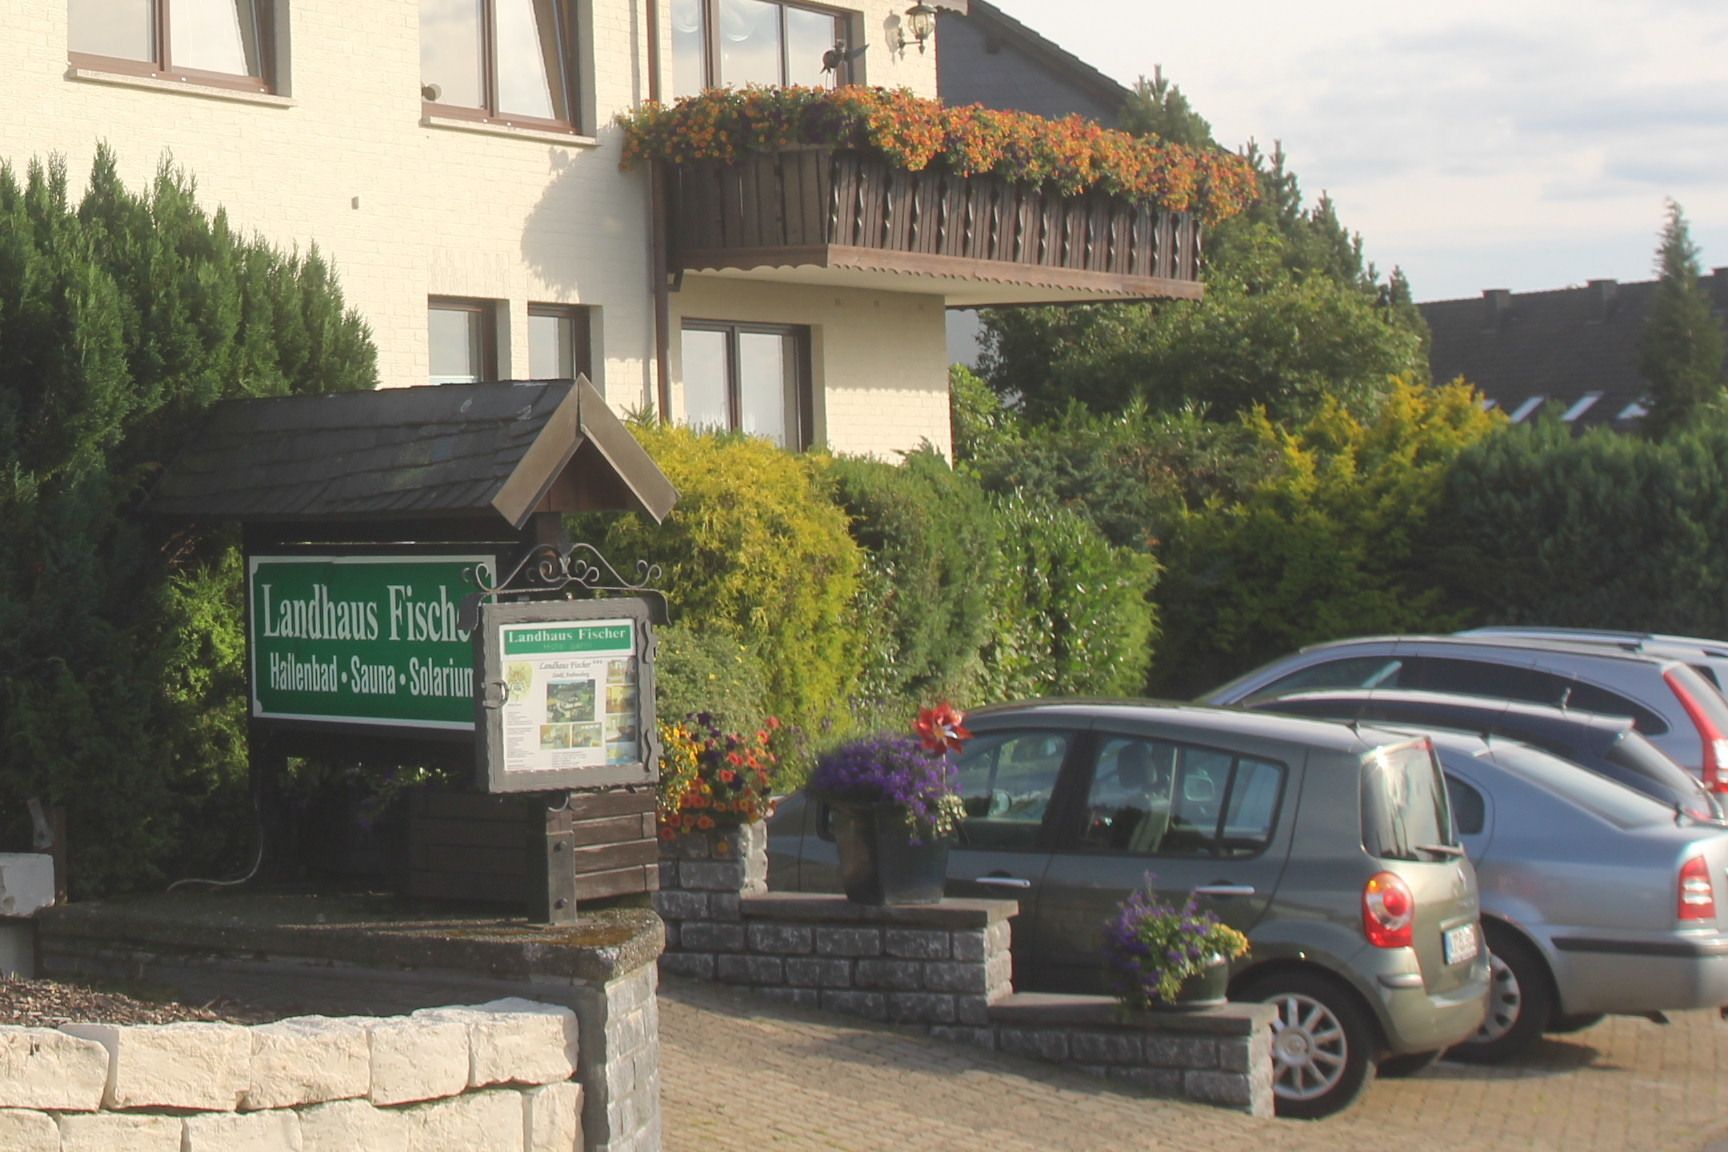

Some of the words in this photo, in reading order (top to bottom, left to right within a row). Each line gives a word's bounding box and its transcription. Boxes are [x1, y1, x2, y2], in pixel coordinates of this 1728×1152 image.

[261, 583, 379, 640] Landhaus
[509, 631, 573, 643] Landhaus
[579, 628, 626, 640] Fischer
[270, 651, 338, 693] Hallenbad
[351, 655, 396, 695] Sauna
